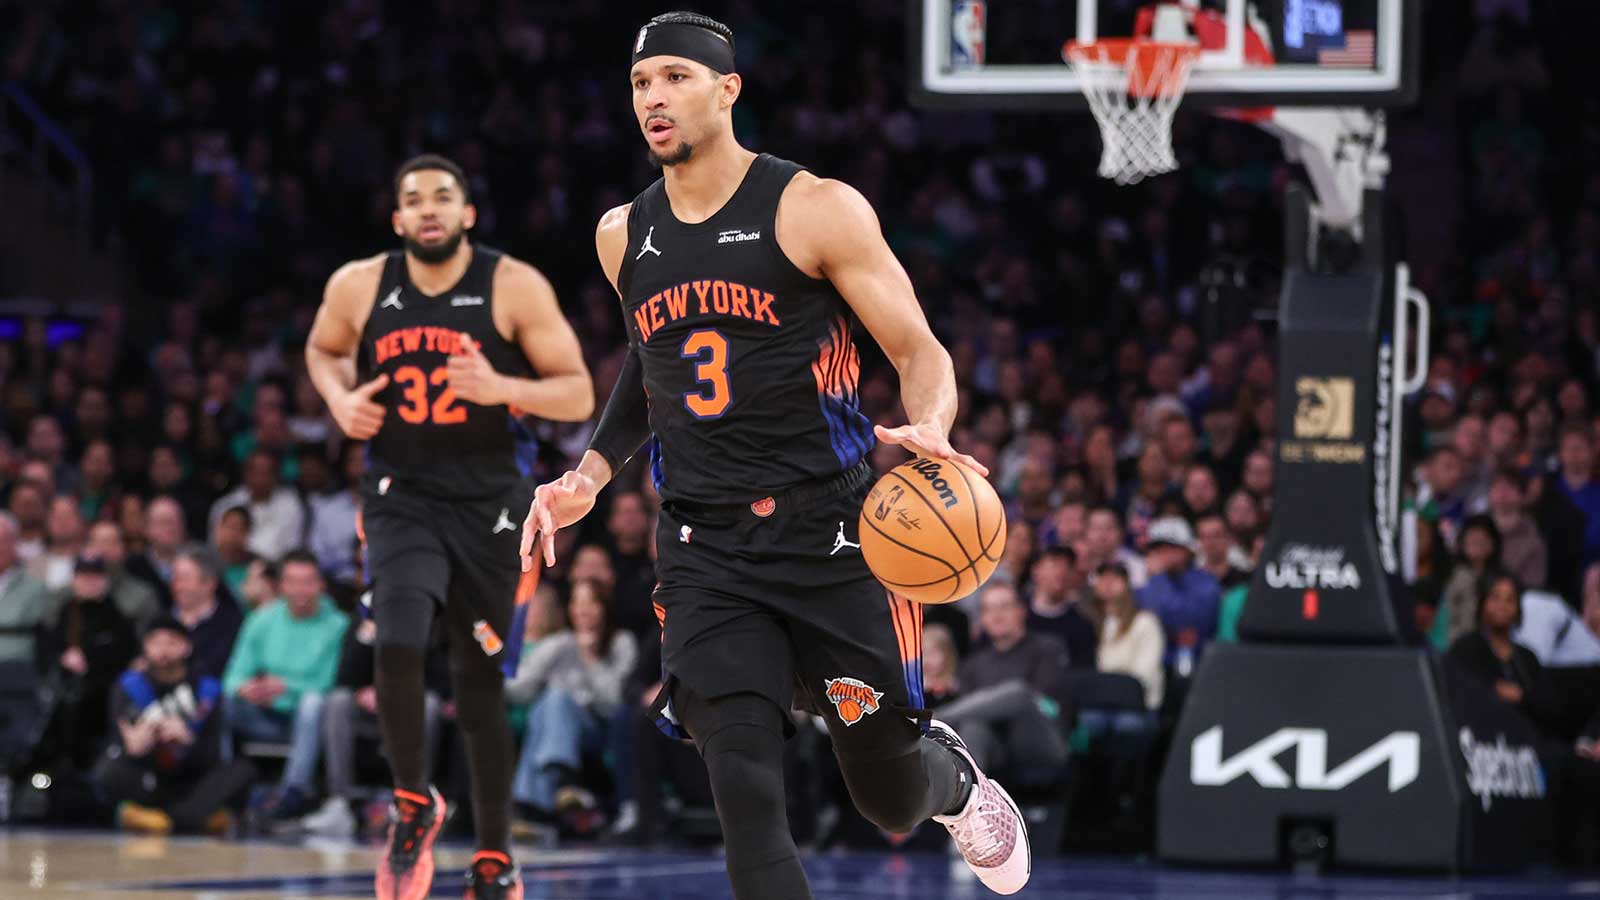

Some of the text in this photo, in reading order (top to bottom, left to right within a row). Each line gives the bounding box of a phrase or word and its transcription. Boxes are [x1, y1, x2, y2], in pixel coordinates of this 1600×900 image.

[718, 234, 735, 244] abu
[735, 231, 761, 242] dhabi
[634, 280, 780, 343] NEW YORK
[375, 327, 424, 365] NEW
[393, 366, 468, 424] 32
[681, 328, 733, 420] 3
[904, 457, 958, 510] ilson
[1265, 561, 1360, 589] ULTRA
[828, 680, 877, 708] KNICKS
[1191, 726, 1420, 793] KIA
